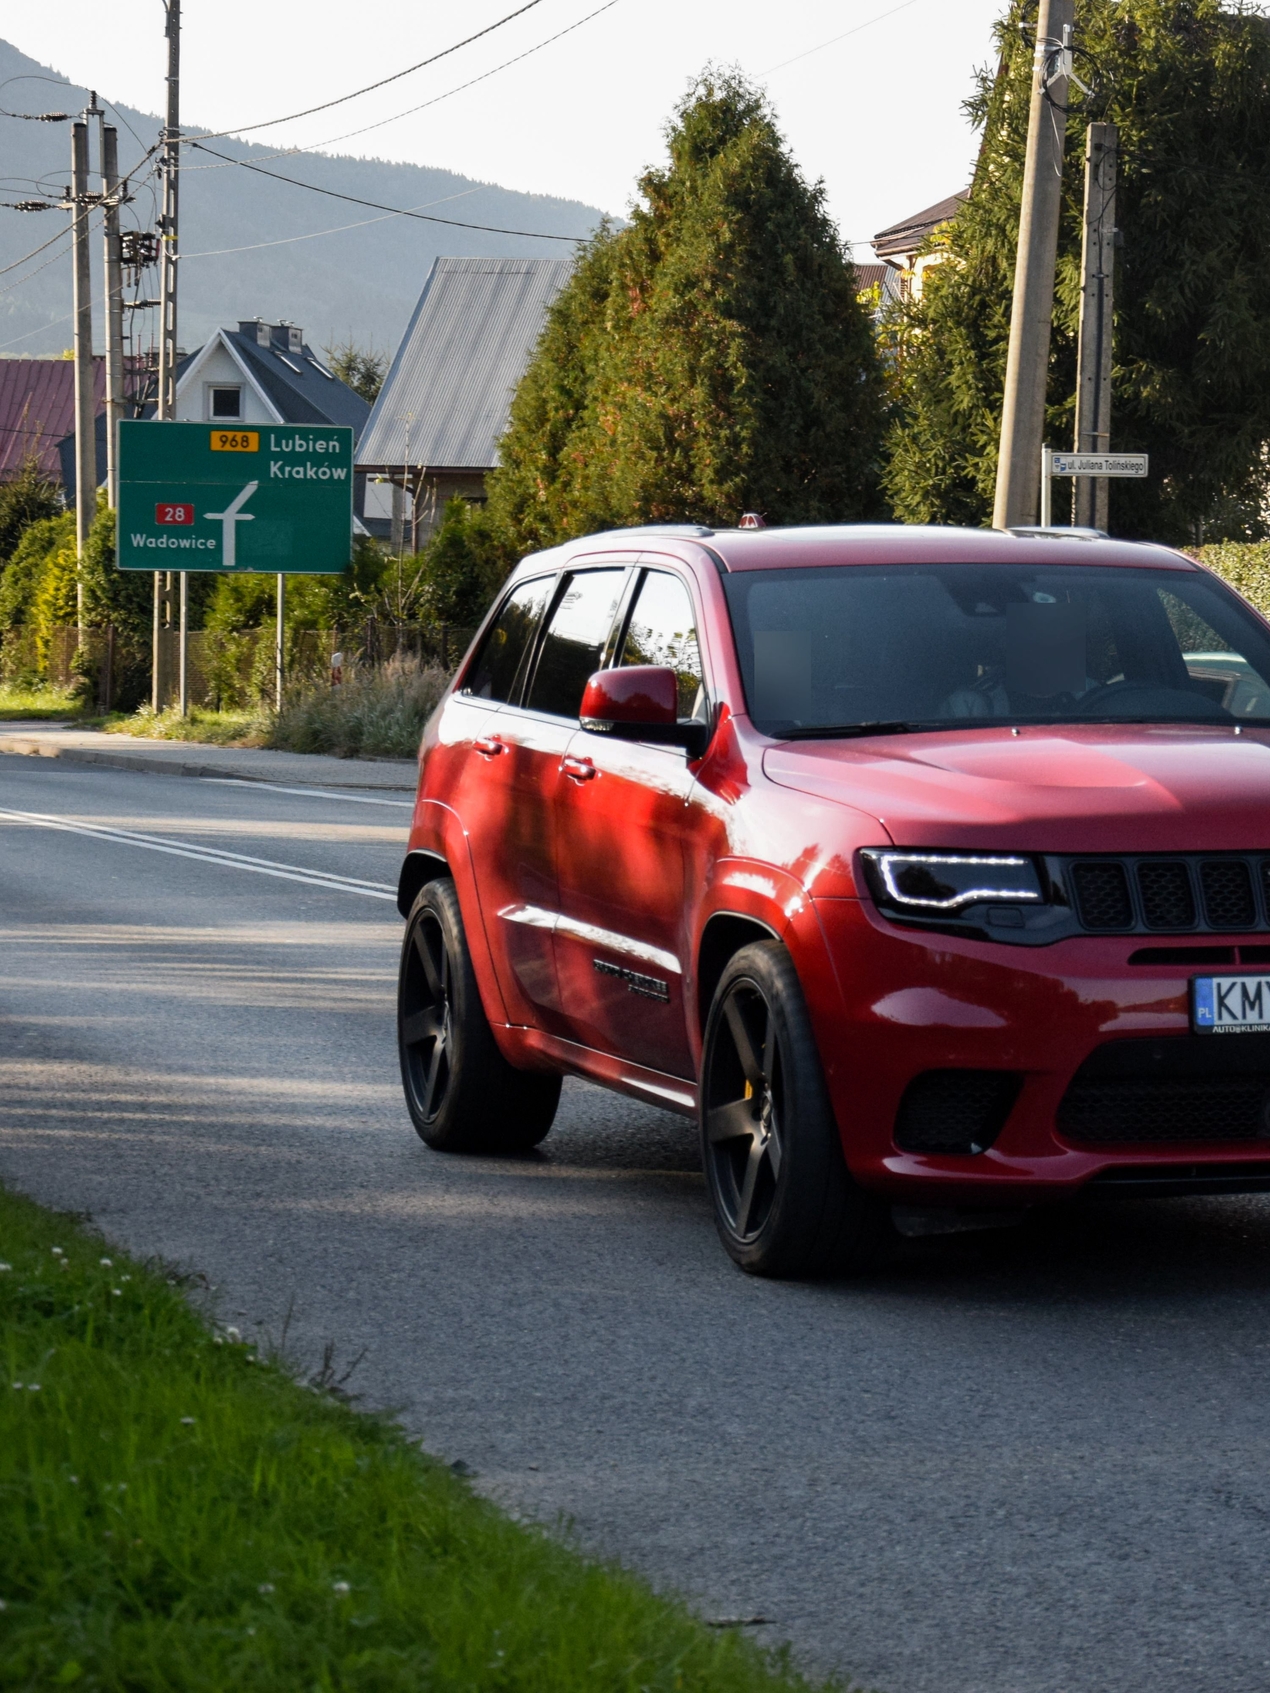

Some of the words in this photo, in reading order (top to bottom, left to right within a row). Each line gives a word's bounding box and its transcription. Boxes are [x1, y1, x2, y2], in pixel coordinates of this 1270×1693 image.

[219, 434, 250, 448] 968
[269, 434, 340, 453] Lubień
[269, 461, 347, 480] Kraków
[1067, 461, 1077, 470] ul.
[1078, 460, 1103, 470] Juliana
[164, 507, 185, 522] 28
[130, 533, 217, 549] Wadowice
[1198, 1008, 1212, 1019] PL
